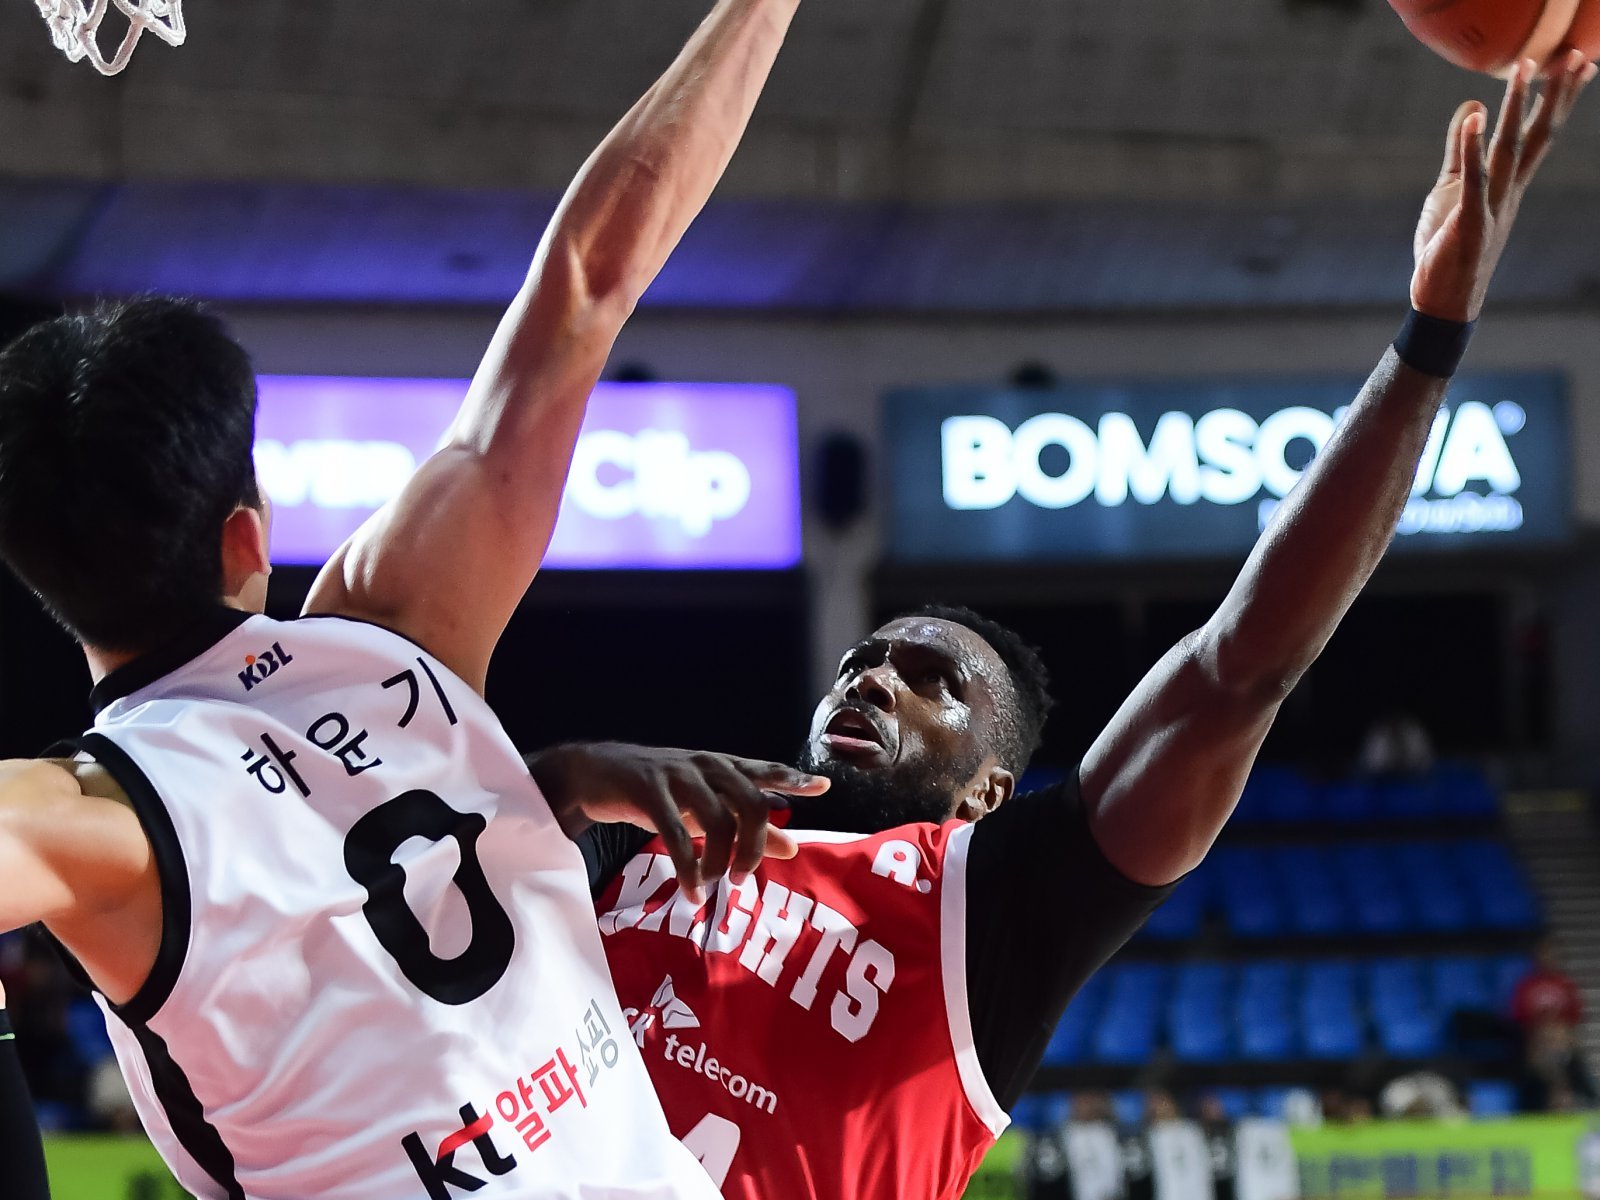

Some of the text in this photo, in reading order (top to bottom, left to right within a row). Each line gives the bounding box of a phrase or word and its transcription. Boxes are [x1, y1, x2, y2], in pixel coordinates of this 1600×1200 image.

[941, 400, 1521, 509] BOMSOA
[238, 642, 293, 691] KBL
[241, 657, 458, 797] 하윤기
[344, 789, 515, 1005] 0
[496, 998, 619, 1152] 알파쇼핑
[664, 1034, 778, 1115] telecom
